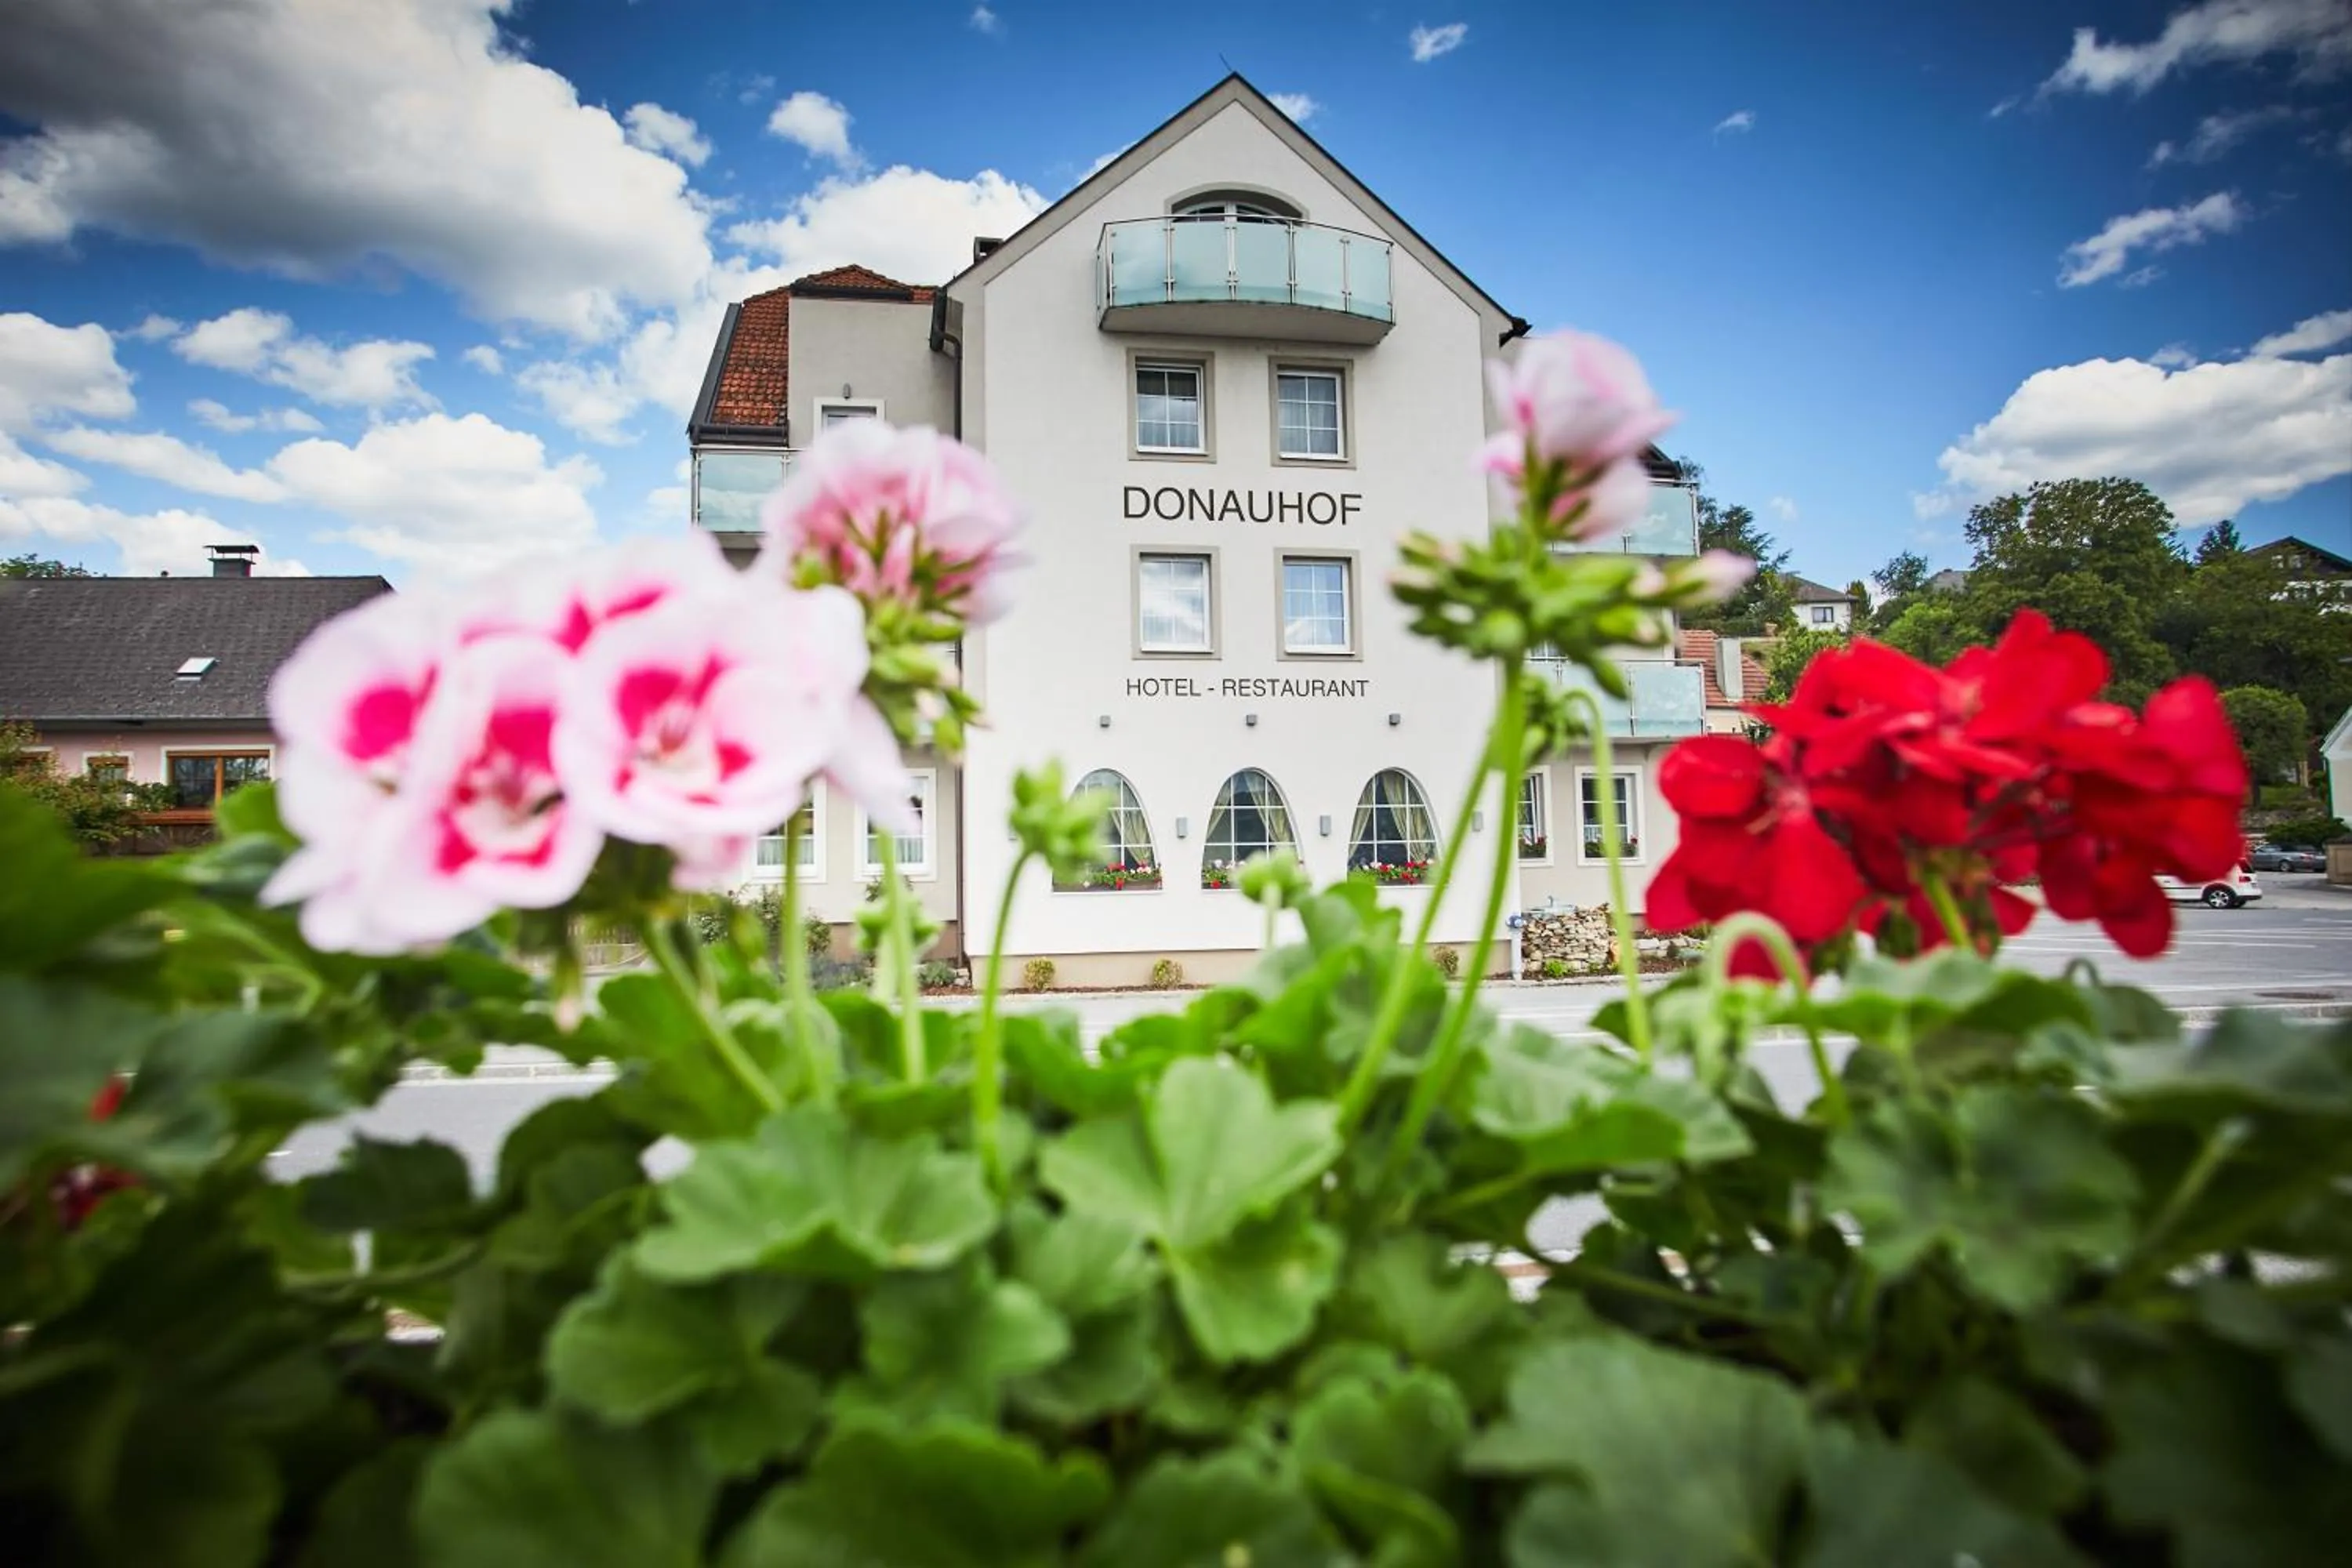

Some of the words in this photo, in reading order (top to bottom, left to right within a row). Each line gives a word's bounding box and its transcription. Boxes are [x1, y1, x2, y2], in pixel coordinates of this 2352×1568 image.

[1123, 486, 1362, 524] DONAUHOF
[1127, 678, 1201, 696] HOTEL
[1221, 679, 1369, 697] RESTAURANT
